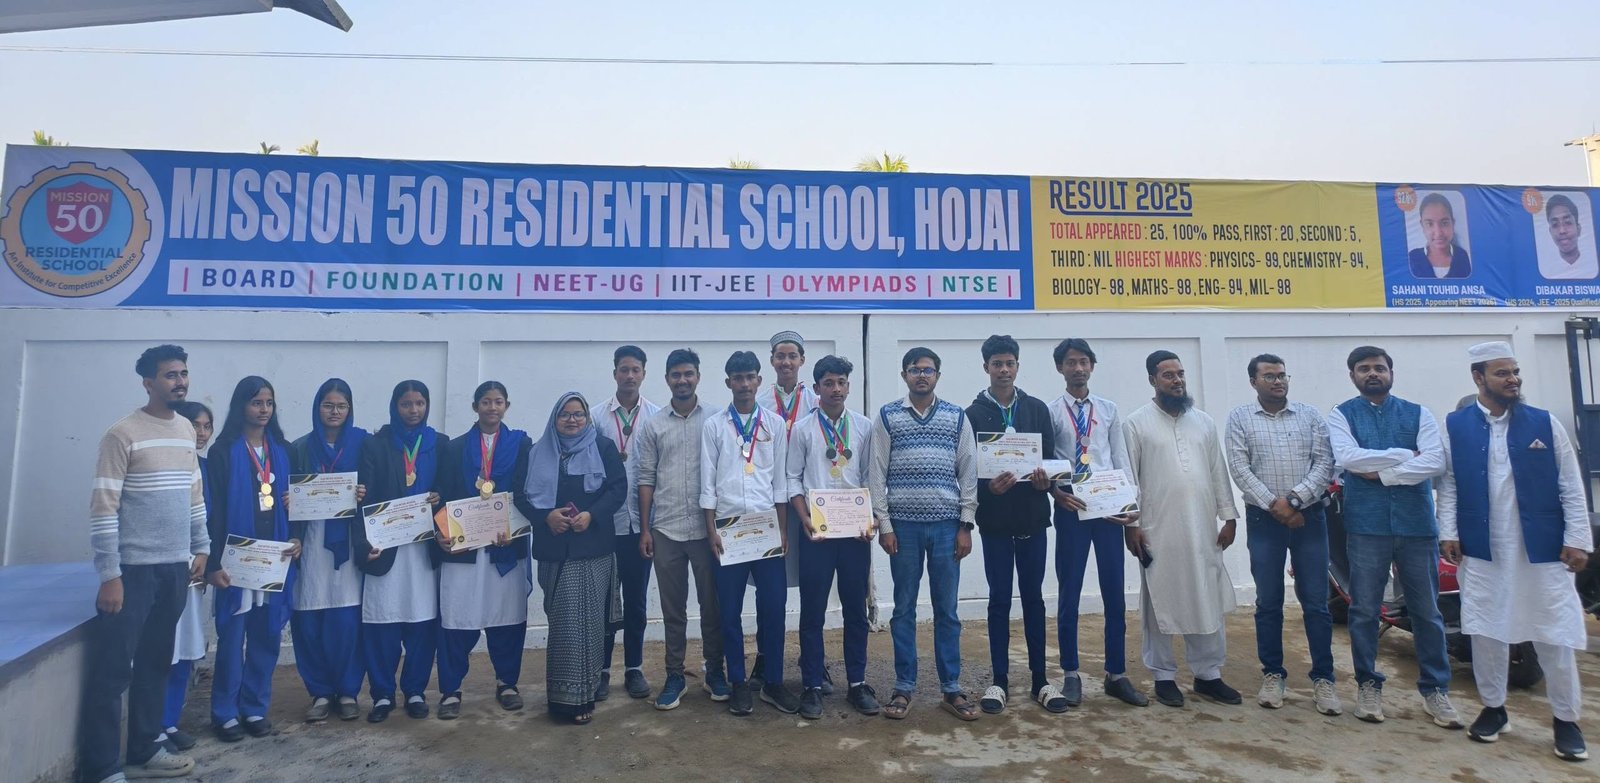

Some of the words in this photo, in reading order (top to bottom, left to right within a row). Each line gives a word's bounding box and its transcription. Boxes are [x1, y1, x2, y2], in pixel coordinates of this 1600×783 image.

[50, 191, 110, 203] MISSION
[1049, 179, 1129, 213] RESULT
[1135, 181, 1193, 211] 2025
[54, 204, 104, 233] 50
[169, 167, 376, 244] MISSION
[386, 175, 449, 246] 50
[460, 177, 729, 248] RESIDENTIAL
[740, 183, 905, 257] SCHOOL,
[914, 186, 1020, 252] HOJAI
[1050, 222, 1083, 240] TOTAL
[1085, 222, 1142, 241] APPEARED
[1172, 223, 1208, 241] 100%
[1244, 224, 1273, 241] FIRST
[1300, 225, 1342, 242] SECOND
[25, 247, 123, 259] RESIDENTIAL
[1051, 250, 1085, 267] THIRD
[1094, 250, 1113, 267] NIL
[1115, 250, 1161, 268] HIGHEST
[1165, 250, 1202, 268] MARKS
[8, 252, 18, 263] An
[16, 261, 45, 284] Institute
[45, 279, 57, 288] for
[57, 279, 105, 293] Competitive
[105, 252, 137, 282] Excellence
[42, 259, 107, 271] SCHOOL
[202, 268, 295, 289] BOARD
[326, 270, 504, 292] FOUNDATION
[533, 273, 644, 293] NEET-UG
[671, 274, 756, 292] IIT-JEE
[782, 275, 917, 293] OLYMPIADS
[943, 276, 998, 293] NTSE
[1277, 279, 1292, 296] 98
[1392, 285, 1426, 295] SAHANI
[1427, 285, 1459, 295] TOUHID
[1461, 285, 1486, 295] ANSA
[1535, 285, 1574, 295] DIBAKAR
[1425, 298, 1459, 307] Appearing
